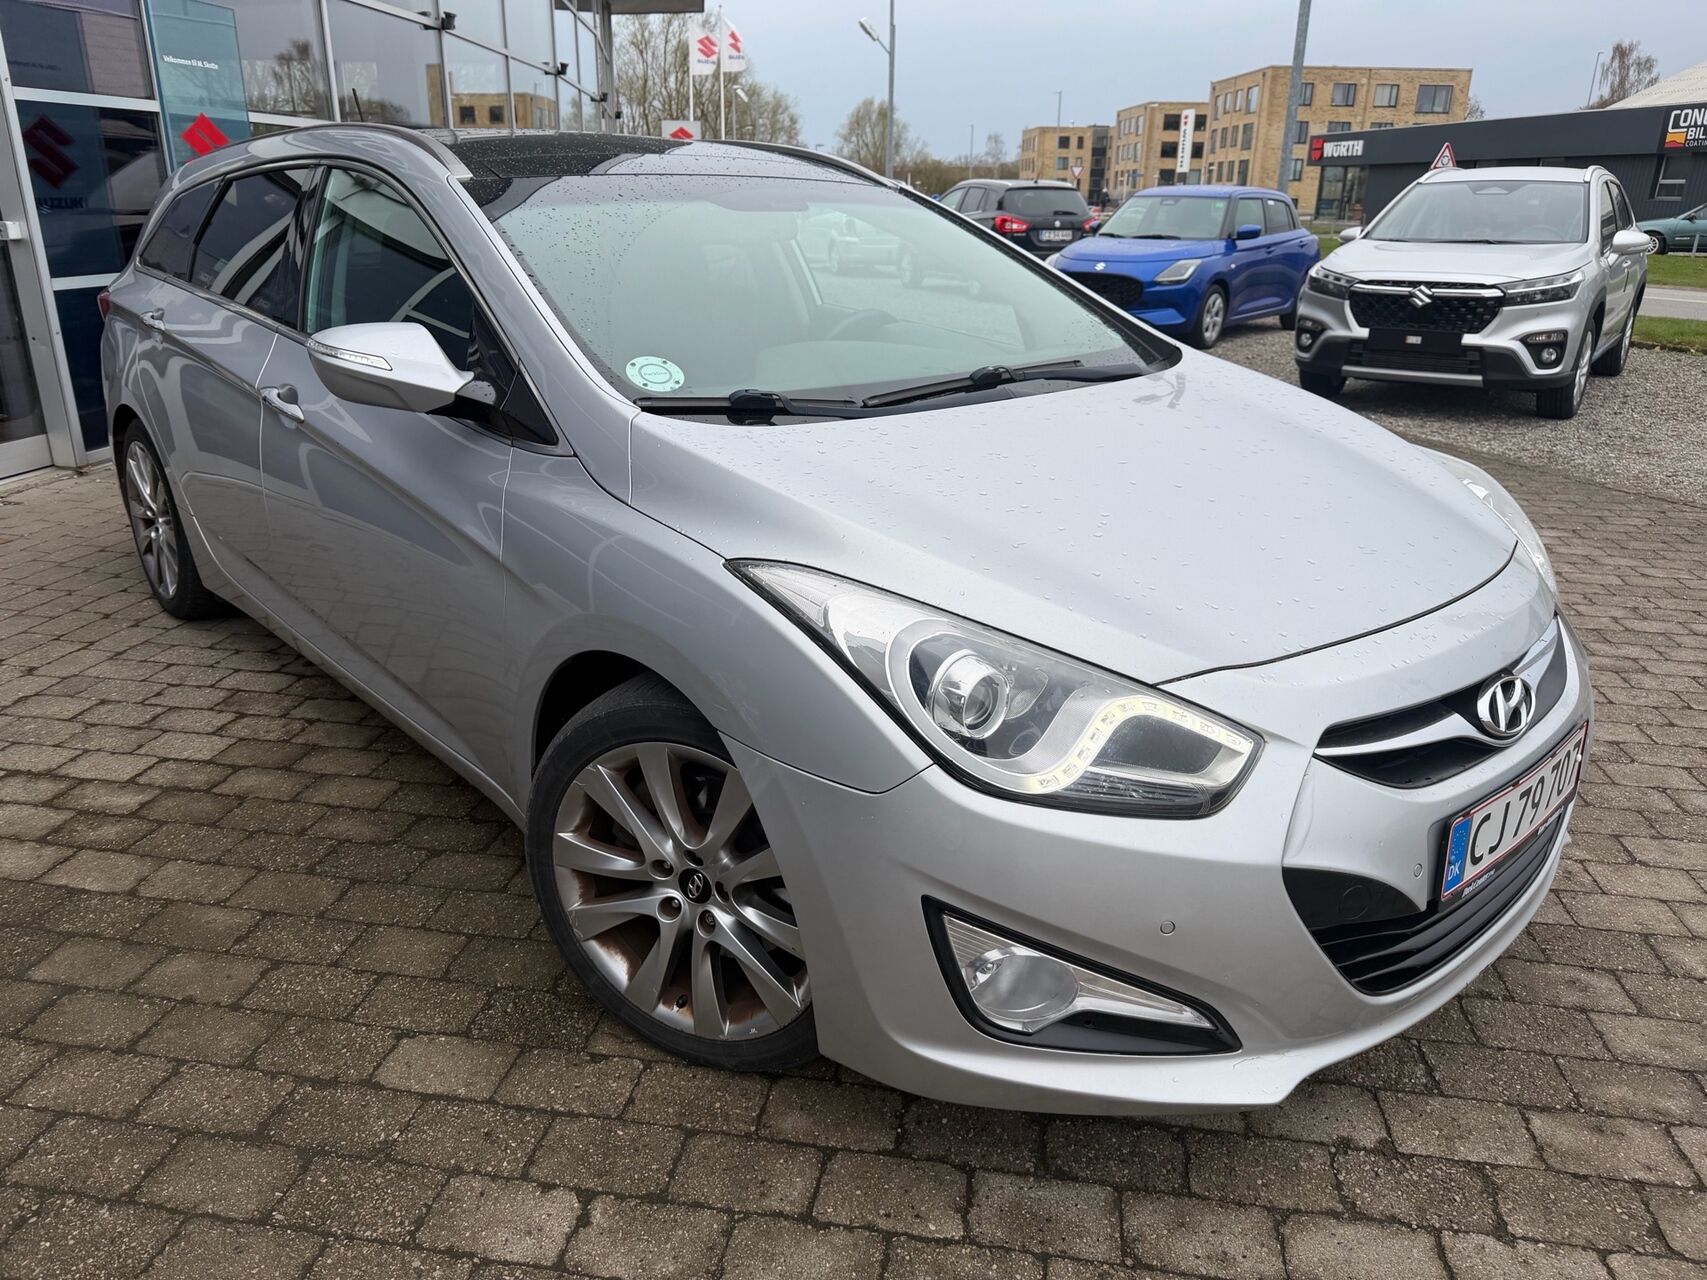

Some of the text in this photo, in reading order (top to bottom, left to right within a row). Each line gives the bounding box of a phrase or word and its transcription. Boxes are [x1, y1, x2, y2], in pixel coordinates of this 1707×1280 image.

[1323, 139, 1364, 158] WÜRTH
[1469, 801, 1511, 866] CJ
[1513, 775, 1545, 839] 79
[1545, 737, 1583, 810] 707
[1447, 859, 1462, 881] DK
